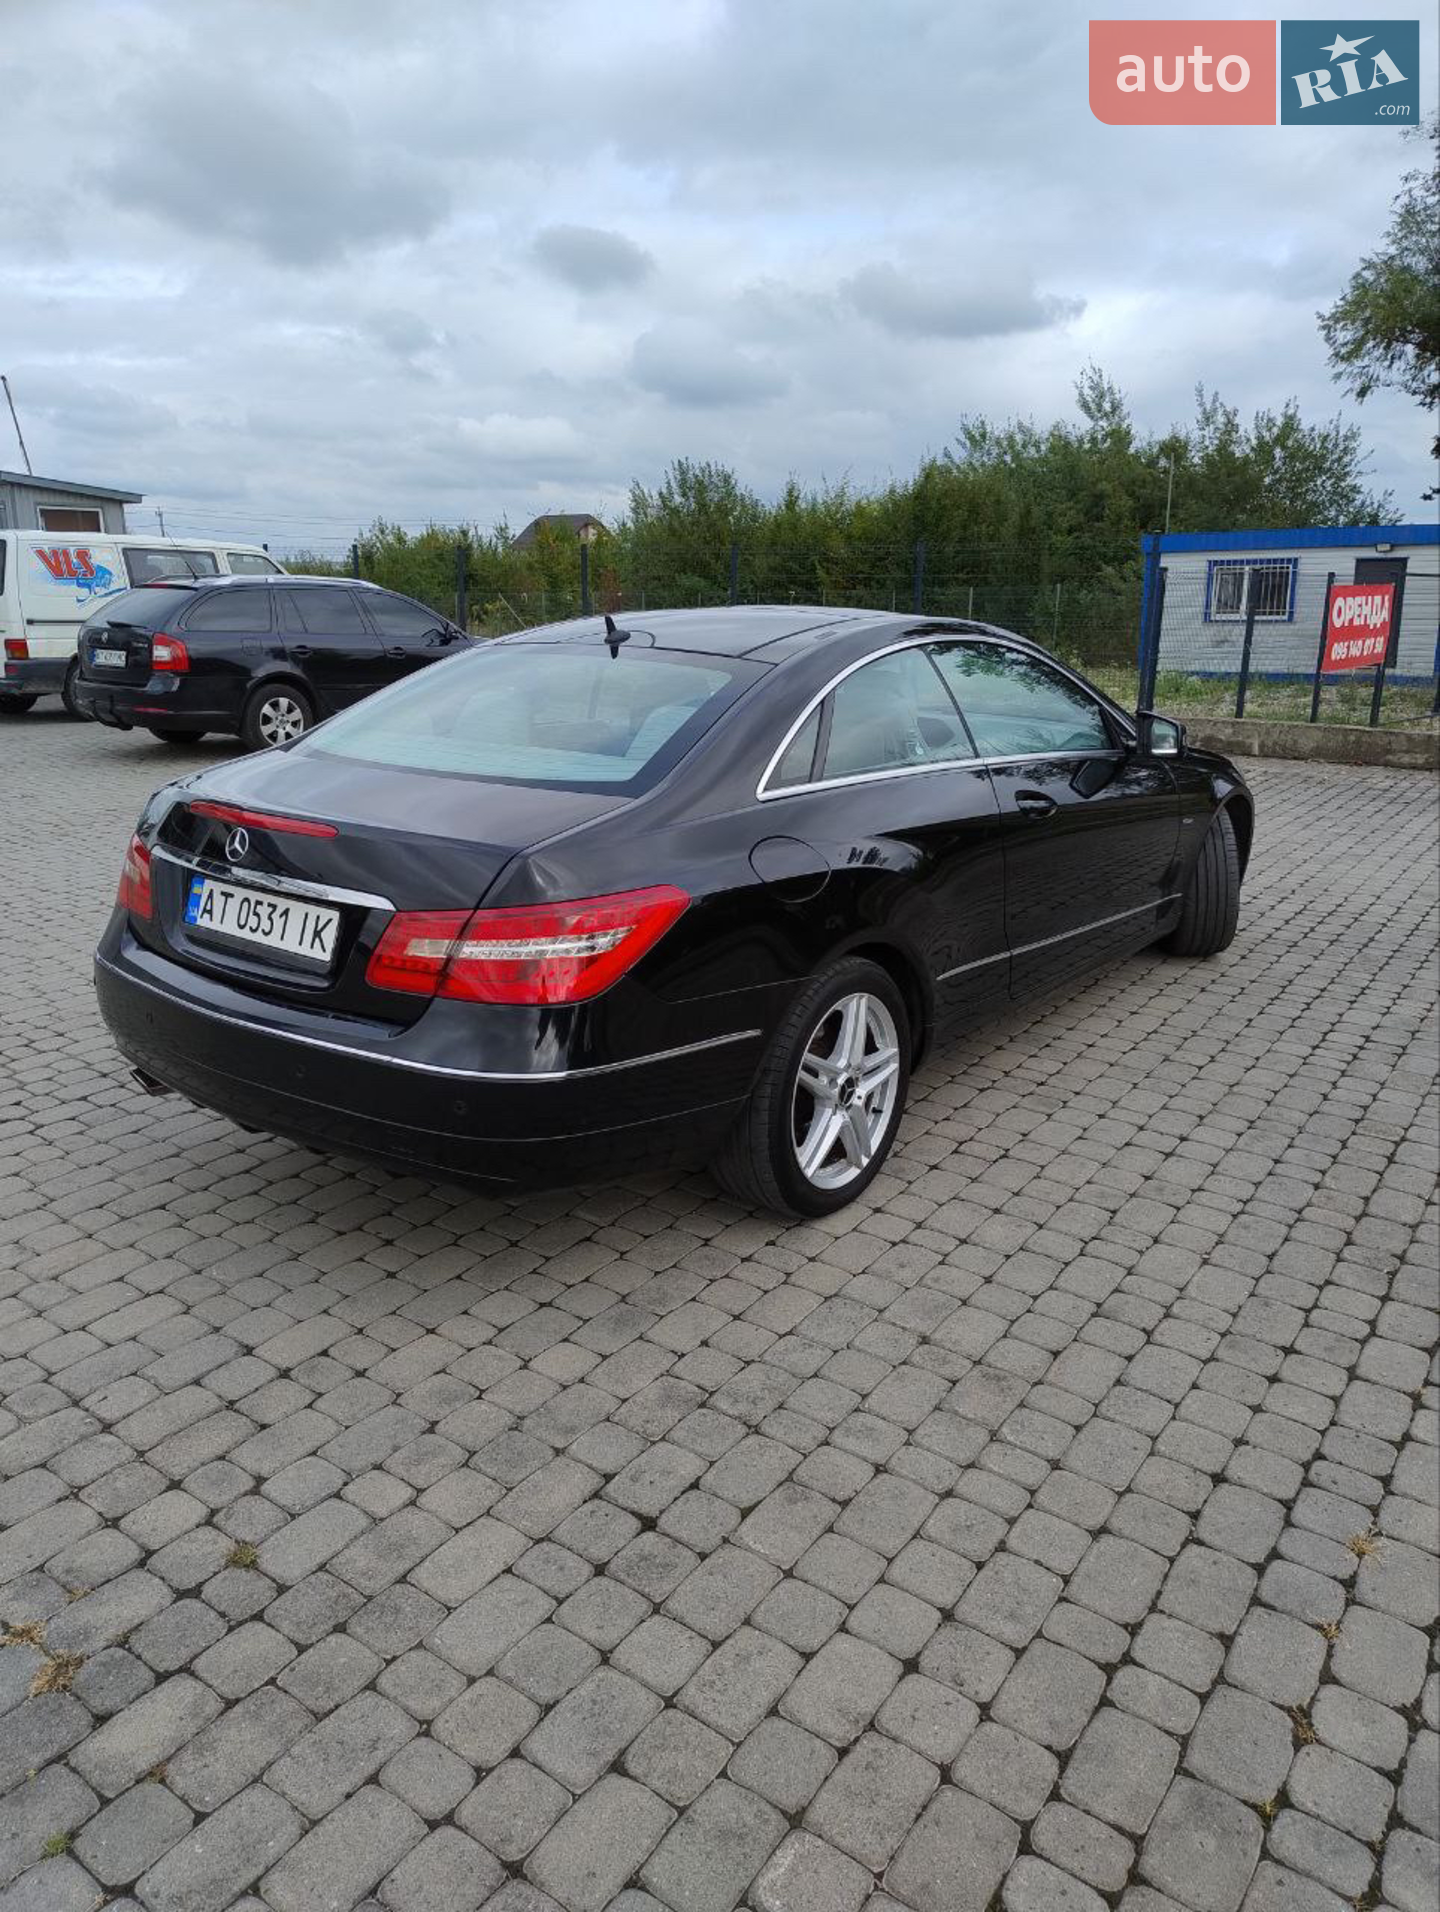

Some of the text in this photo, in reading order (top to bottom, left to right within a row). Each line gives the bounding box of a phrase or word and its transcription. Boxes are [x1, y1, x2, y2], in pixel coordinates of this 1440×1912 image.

[35, 548, 97, 580] VLS
[1332, 595, 1390, 629] ОРЕНДА
[1331, 641, 1348, 661] 095
[200, 887, 333, 953] AT 0531 IK
